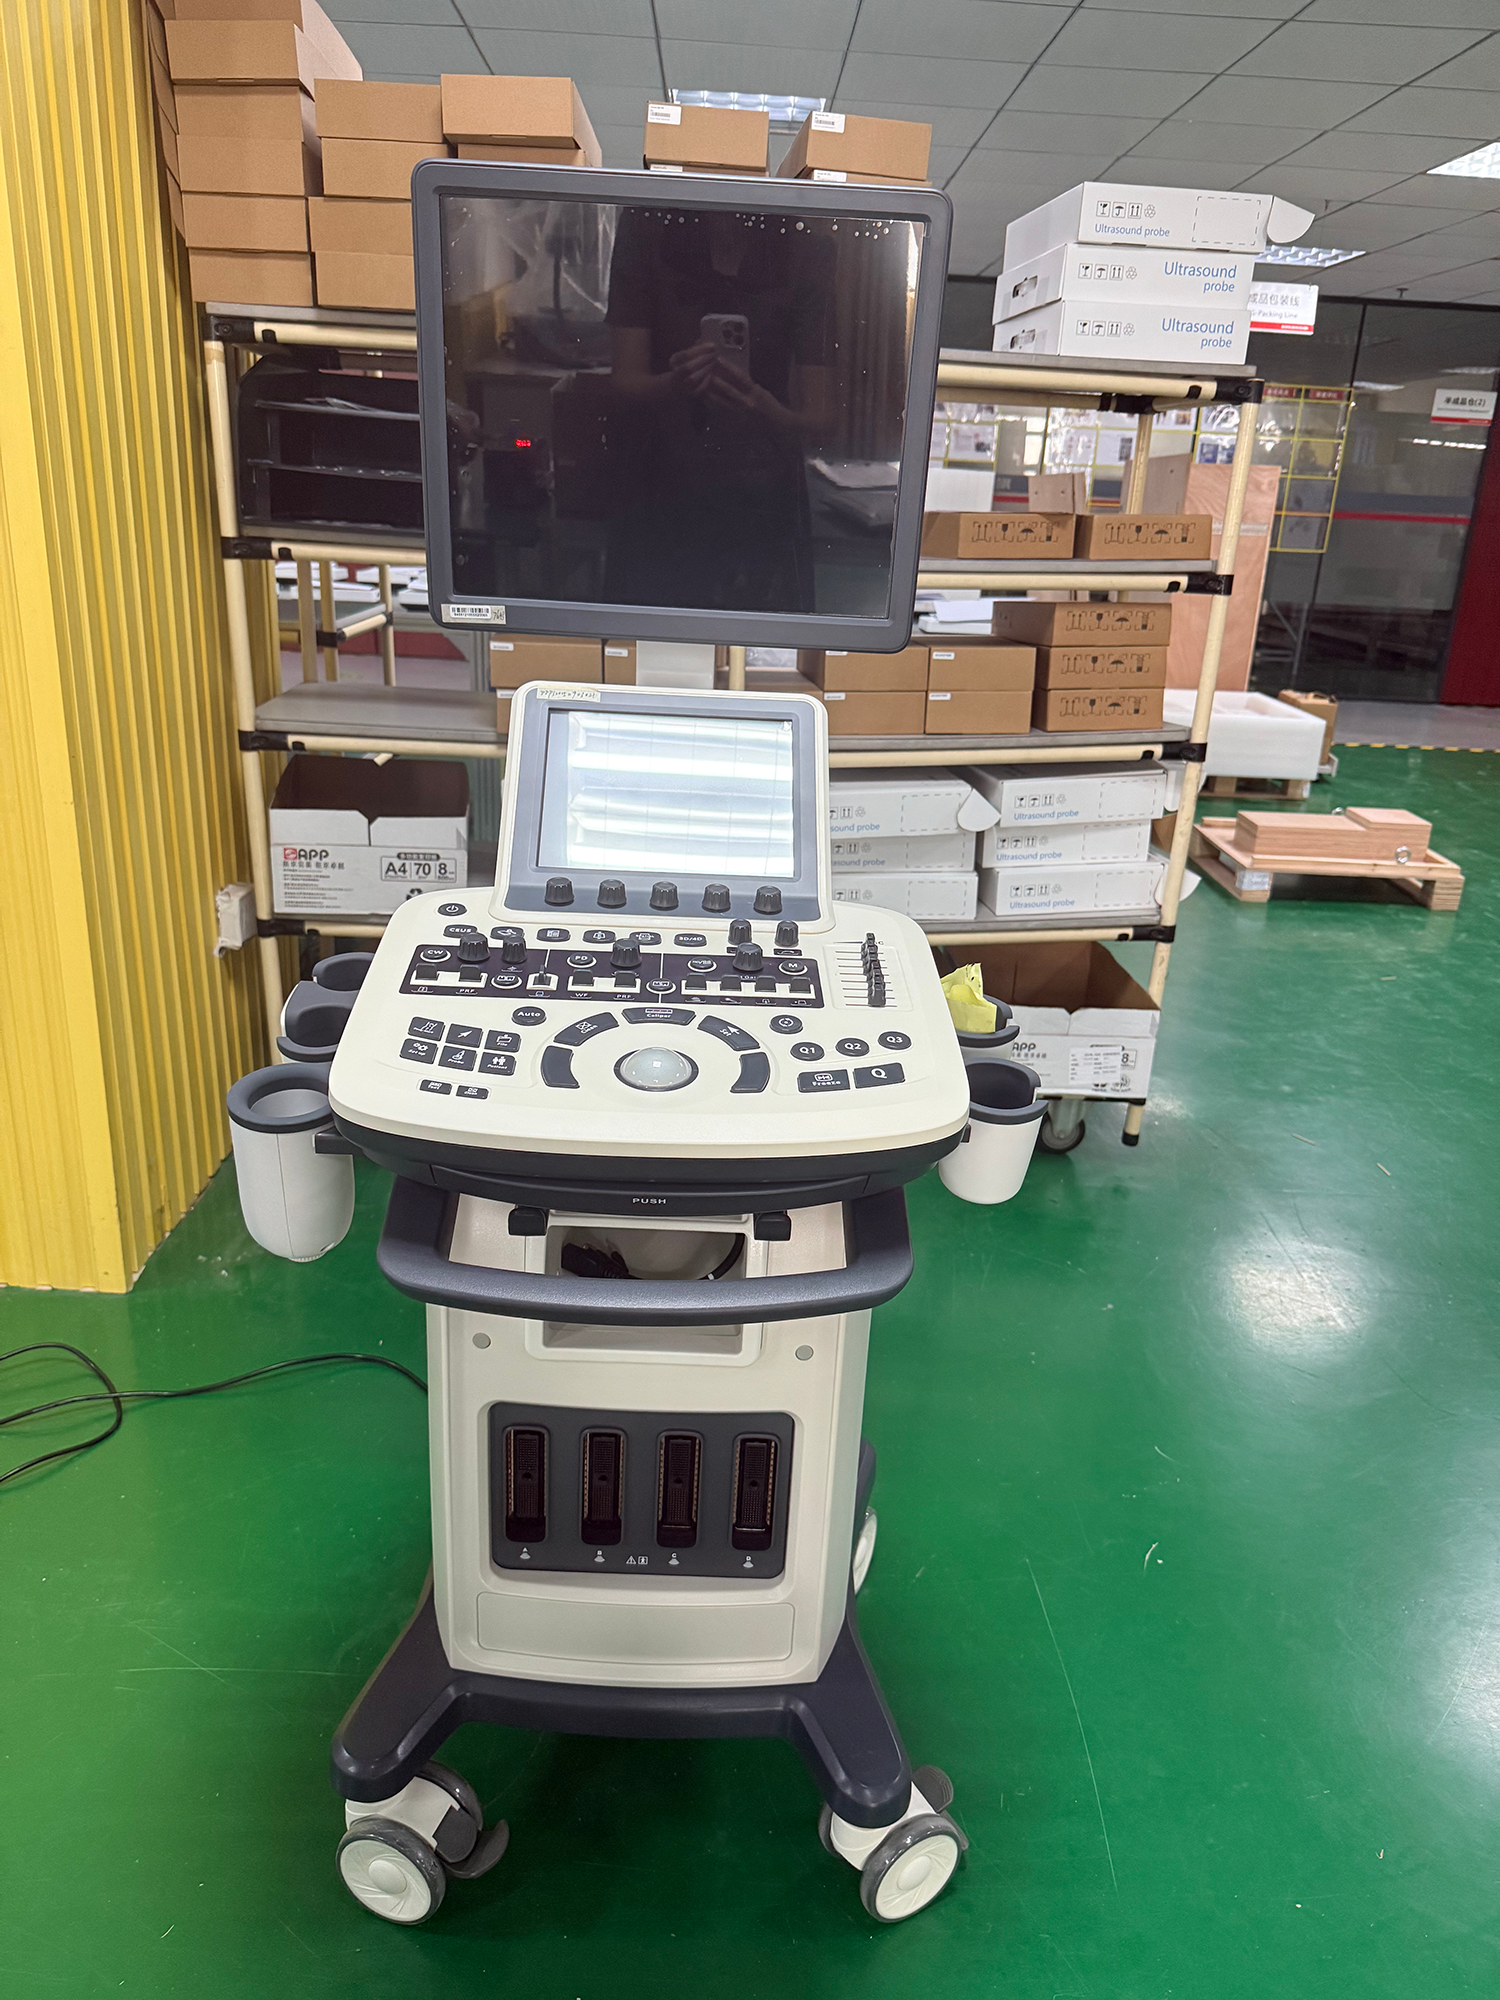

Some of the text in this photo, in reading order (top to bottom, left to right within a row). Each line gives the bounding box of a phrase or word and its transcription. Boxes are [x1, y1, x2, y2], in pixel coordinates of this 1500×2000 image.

[1094, 223, 1170, 238] Ultrasound probe
[1163, 261, 1237, 279] Ultrasound
[1203, 280, 1235, 293] probe
[1161, 318, 1234, 335] Ultrasound
[1200, 336, 1233, 349] probe
[1013, 810, 1079, 821] Ultrasound probe
[857, 823, 880, 833] probe
[298, 849, 329, 861] APP
[996, 851, 1063, 861] Ultrasound probe
[385, 861, 407, 875] A4
[862, 859, 886, 867] probe
[414, 862, 431, 876] 70
[438, 862, 447, 876] 8
[1010, 899, 1076, 910] Ultrasound probe
[886, 1035, 903, 1044] Q3
[799, 1046, 816, 1055] Q1
[844, 1041, 862, 1050] Q2
[1012, 1042, 1036, 1052] APP
[1121, 1053, 1129, 1063] 8
[870, 1068, 887, 1079] Q
[632, 1197, 667, 1205] PUSH
